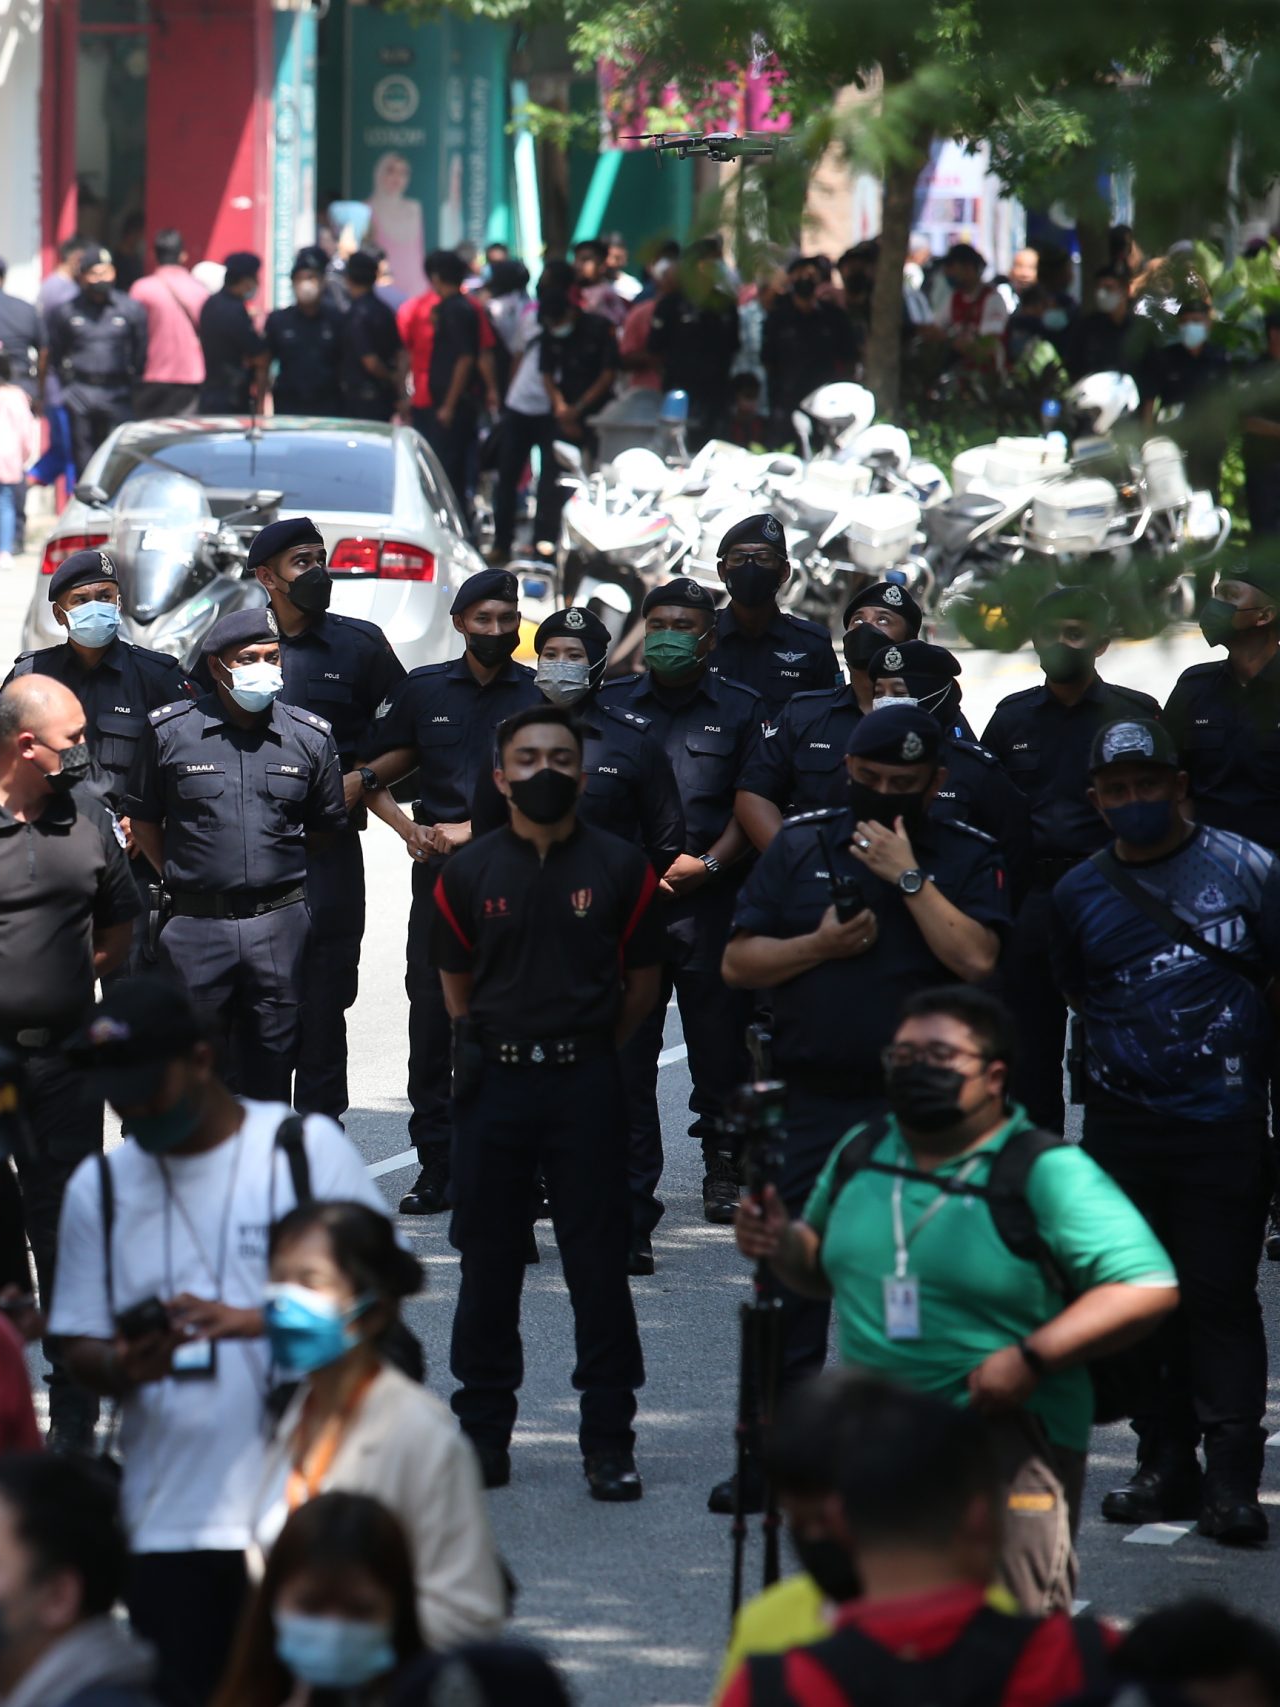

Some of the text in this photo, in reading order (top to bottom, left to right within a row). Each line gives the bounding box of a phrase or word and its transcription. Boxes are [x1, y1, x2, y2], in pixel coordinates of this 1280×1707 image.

[115, 706, 131, 714] POLIS
[704, 725, 721, 733] POLIS
[280, 766, 298, 774] POLIS
[598, 767, 617, 775] POLIS
